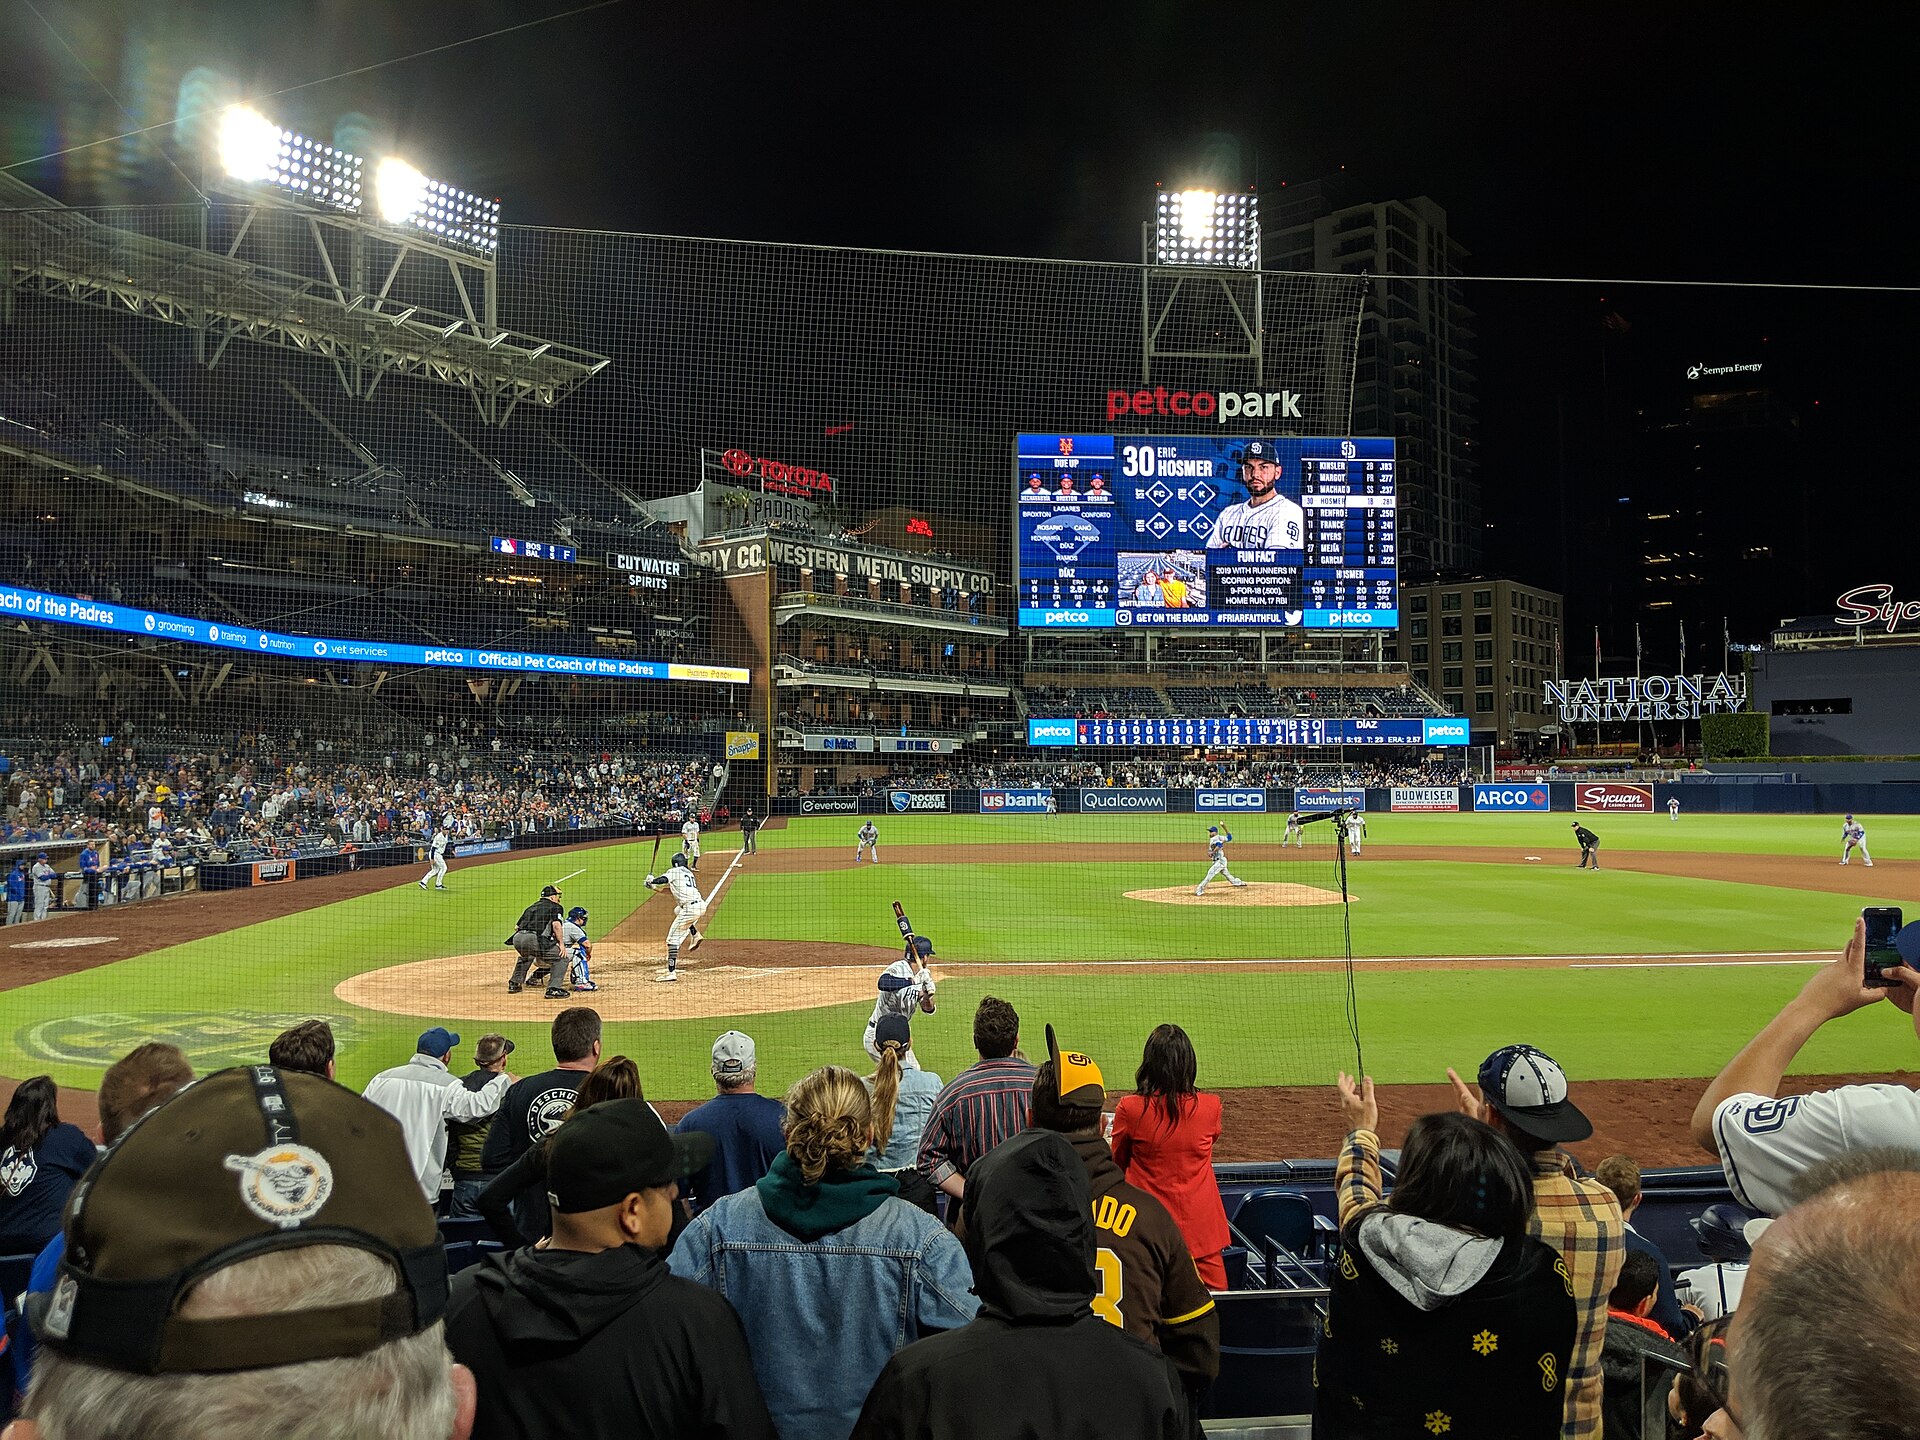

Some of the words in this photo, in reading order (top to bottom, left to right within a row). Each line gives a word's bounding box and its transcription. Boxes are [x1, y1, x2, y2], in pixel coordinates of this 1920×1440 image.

[1703, 367, 1733, 375] Sempra
[1735, 363, 1762, 372] Energy
[1107, 386, 1216, 421] petco
[1218, 390, 1302, 423] park
[1054, 459, 1068, 467] DUE
[1069, 459, 1079, 468] UP
[1123, 446, 1155, 476] 30
[1157, 447, 1176, 458] ERIC
[1320, 462, 1345, 470] KINSLER
[758, 458, 831, 491] TOYOTA
[1158, 460, 1212, 476] HOSMER
[755, 497, 810, 522] PADRES
[1321, 521, 1344, 529] FRANCE
[526, 542, 541, 550] BOS
[564, 551, 570, 559] F
[526, 550, 540, 558] BAL
[1321, 543, 1339, 552] MEJÍA
[737, 544, 766, 569] CO.
[1237, 551, 1257, 563] FUN
[1258, 551, 1276, 563] FACT
[618, 554, 680, 576] CUTWATER
[769, 541, 849, 572] WESTERN
[857, 556, 907, 582] METAL
[911, 565, 965, 590] SUPPLY
[970, 575, 993, 594] CO.
[1059, 567, 1075, 577] DÍAZ
[629, 574, 667, 590] SPIRITS
[1221, 577, 1254, 585] SCORING
[1255, 577, 1291, 585] POSITION:
[1230, 587, 1261, 595] 9-FOR-18
[1249, 597, 1267, 606] RUN,
[26, 595, 41, 612] of
[44, 598, 67, 616] the
[70, 603, 113, 624] Padres
[158, 620, 195, 635] grooming
[1045, 611, 1088, 624] petco
[1137, 614, 1154, 622] GET
[1155, 614, 1165, 622] ON
[1166, 614, 1182, 622] THE
[1183, 614, 1209, 622] BOARD
[1217, 614, 1281, 623] #FRIARFAITHFUL
[1330, 612, 1372, 625] petco
[221, 630, 247, 645] training
[331, 645, 347, 654] vet
[350, 645, 388, 657] services
[425, 649, 463, 664] petco
[479, 653, 521, 668] Official
[524, 655, 545, 668] Pet
[547, 658, 582, 672] Coach
[585, 660, 597, 672] of
[599, 661, 616, 673] the
[618, 662, 654, 676] Padres
[1560, 699, 1744, 723] UNIVERSITY
[1289, 720, 1297, 730] B
[1301, 720, 1309, 730] S
[1312, 720, 1321, 730] O
[1034, 726, 1071, 738] petco
[1227, 726, 1239, 734] 12
[1258, 726, 1270, 734] 10
[1289, 731, 1296, 744] 1
[1301, 731, 1308, 744] 1
[1312, 731, 1320, 744] 1
[1429, 726, 1464, 738] petco
[835, 738, 857, 750] Mitel
[1227, 736, 1239, 744] 12
[1260, 736, 1267, 744] 5
[1276, 736, 1283, 744] 2
[728, 738, 757, 757] Snapple
[779, 752, 794, 765] 336
[912, 793, 945, 802] ROCKET
[983, 795, 1004, 807] us
[1004, 792, 1047, 807] bank
[1084, 793, 1163, 808] Qualcomm
[1198, 793, 1263, 806] GEICO
[1299, 795, 1353, 806] Southwest
[1396, 791, 1453, 800] BUDWEISER
[1477, 791, 1527, 804] ARCO
[1584, 787, 1642, 808] Sycuan
[814, 800, 856, 810] everbowl
[912, 800, 946, 809] LEAGUE
